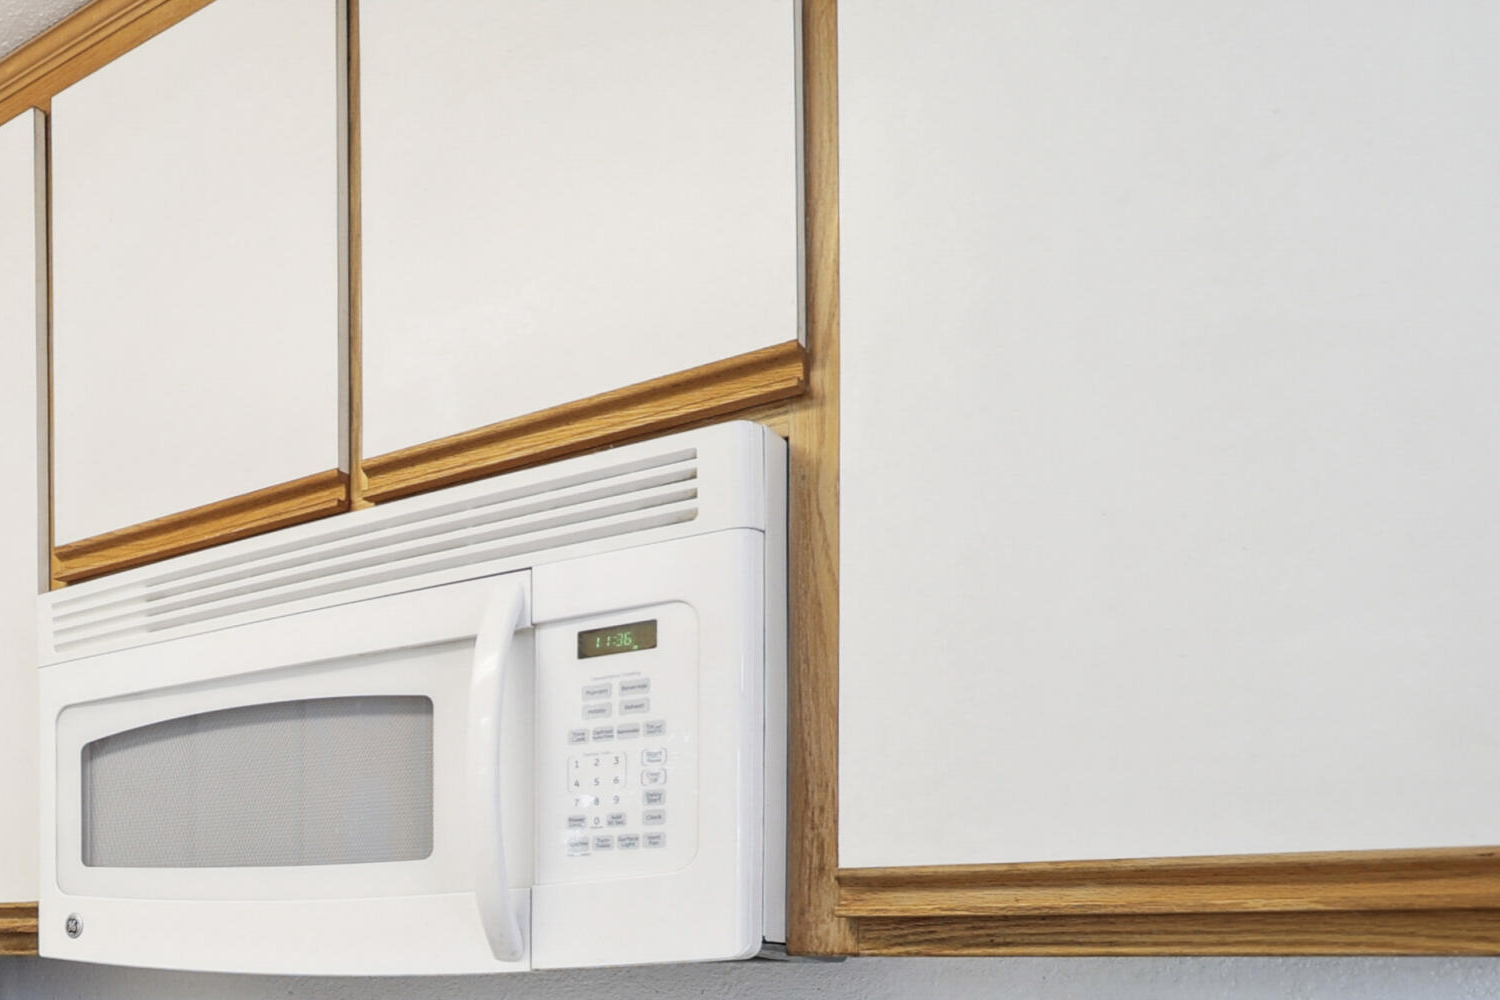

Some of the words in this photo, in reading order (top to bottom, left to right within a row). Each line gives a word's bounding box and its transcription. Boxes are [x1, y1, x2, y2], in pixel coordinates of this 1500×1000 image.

[596, 632, 632, 648] 11:36
[574, 759, 579, 769] 1
[593, 758, 600, 767] 2
[613, 756, 619, 765] 3
[574, 780, 580, 788] 4
[594, 777, 600, 786] 5
[613, 776, 619, 784] 6
[574, 798, 580, 807] 7
[593, 797, 600, 806] 8
[613, 795, 619, 804] 9
[593, 816, 600, 825] 0
